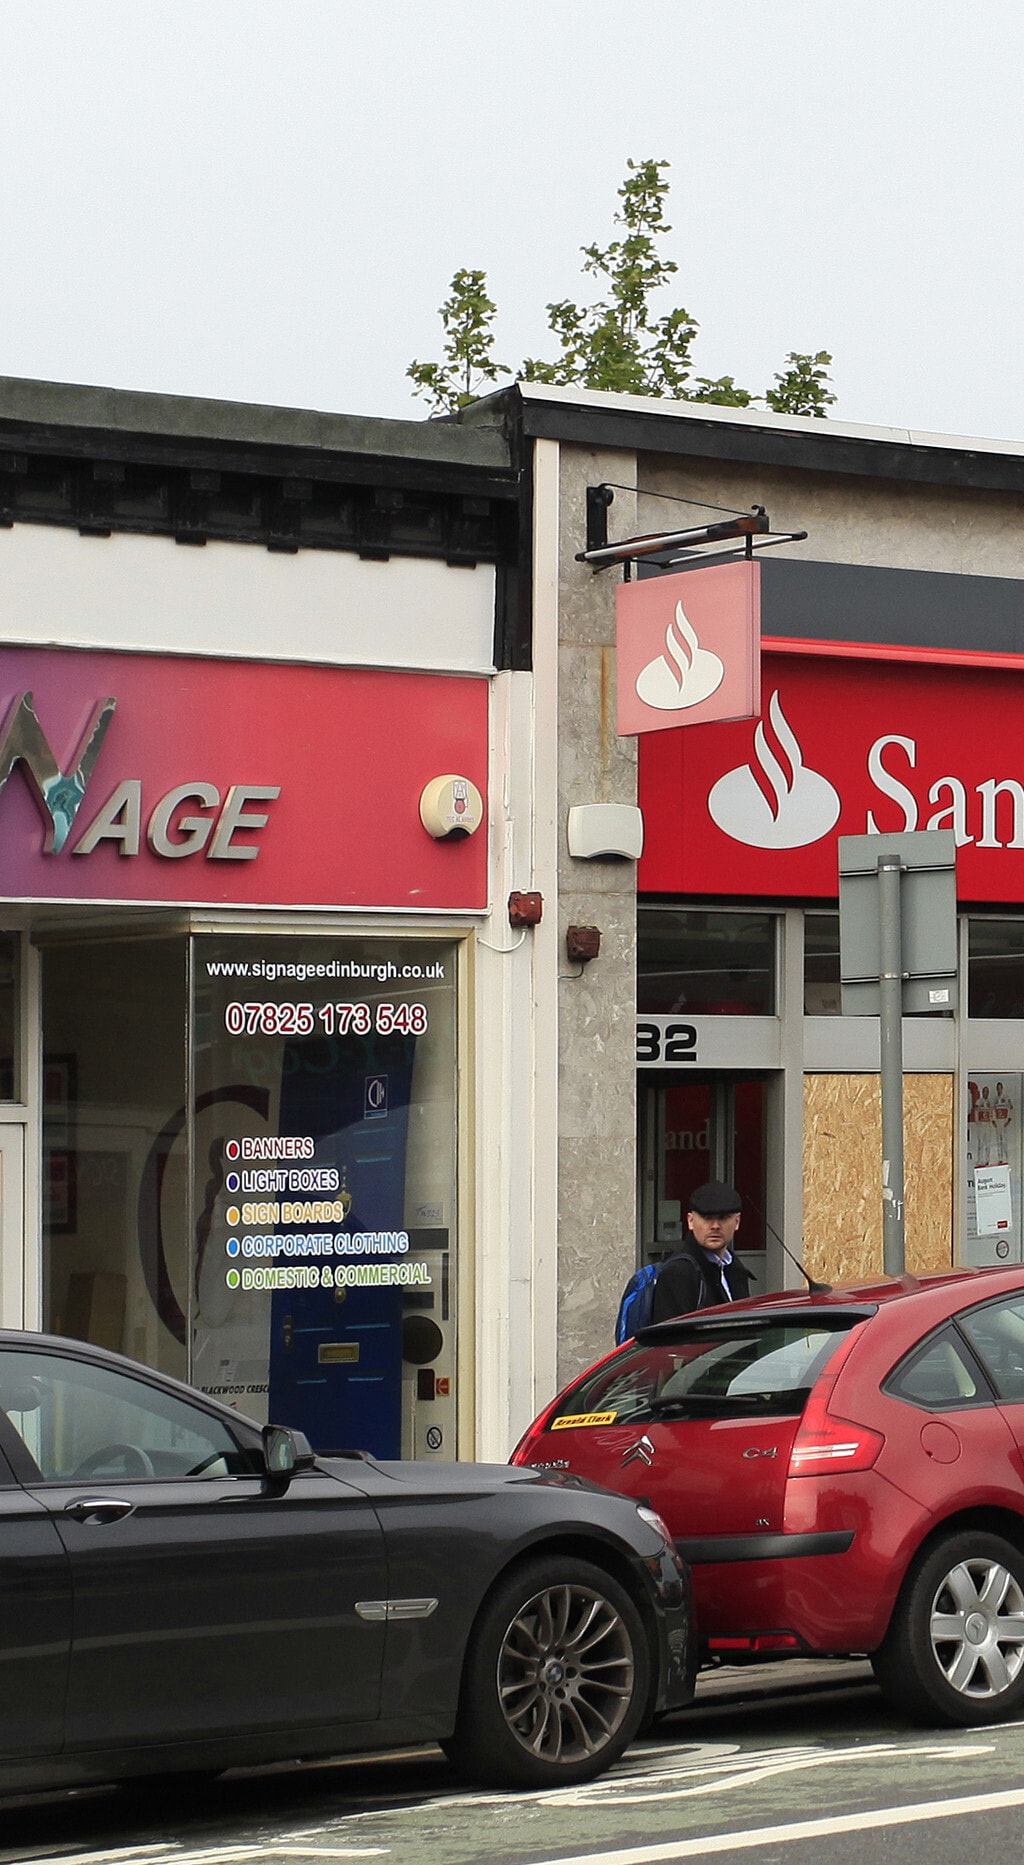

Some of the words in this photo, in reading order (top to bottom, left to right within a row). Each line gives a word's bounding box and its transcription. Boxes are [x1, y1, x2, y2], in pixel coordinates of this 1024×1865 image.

[206, 960, 445, 981] www.signageedinburgh.co.uk
[225, 1002, 314, 1035] 07825
[319, 1003, 372, 1035] 173
[376, 1003, 428, 1035] 548
[242, 1137, 314, 1159] BANNERS
[242, 1170, 288, 1192] LIGHT
[289, 1168, 340, 1191] BOXES
[242, 1202, 280, 1224] SIGN
[281, 1200, 344, 1224] BOARDS
[242, 1233, 333, 1257] CORPORATE
[333, 1231, 410, 1255] CLOTHING
[242, 1265, 321, 1290] DOMESTIC
[321, 1265, 334, 1288] &
[334, 1263, 432, 1287] COMMERCIAL
[587, 1414, 612, 1423] Clark
[742, 1447, 778, 1460] C4
